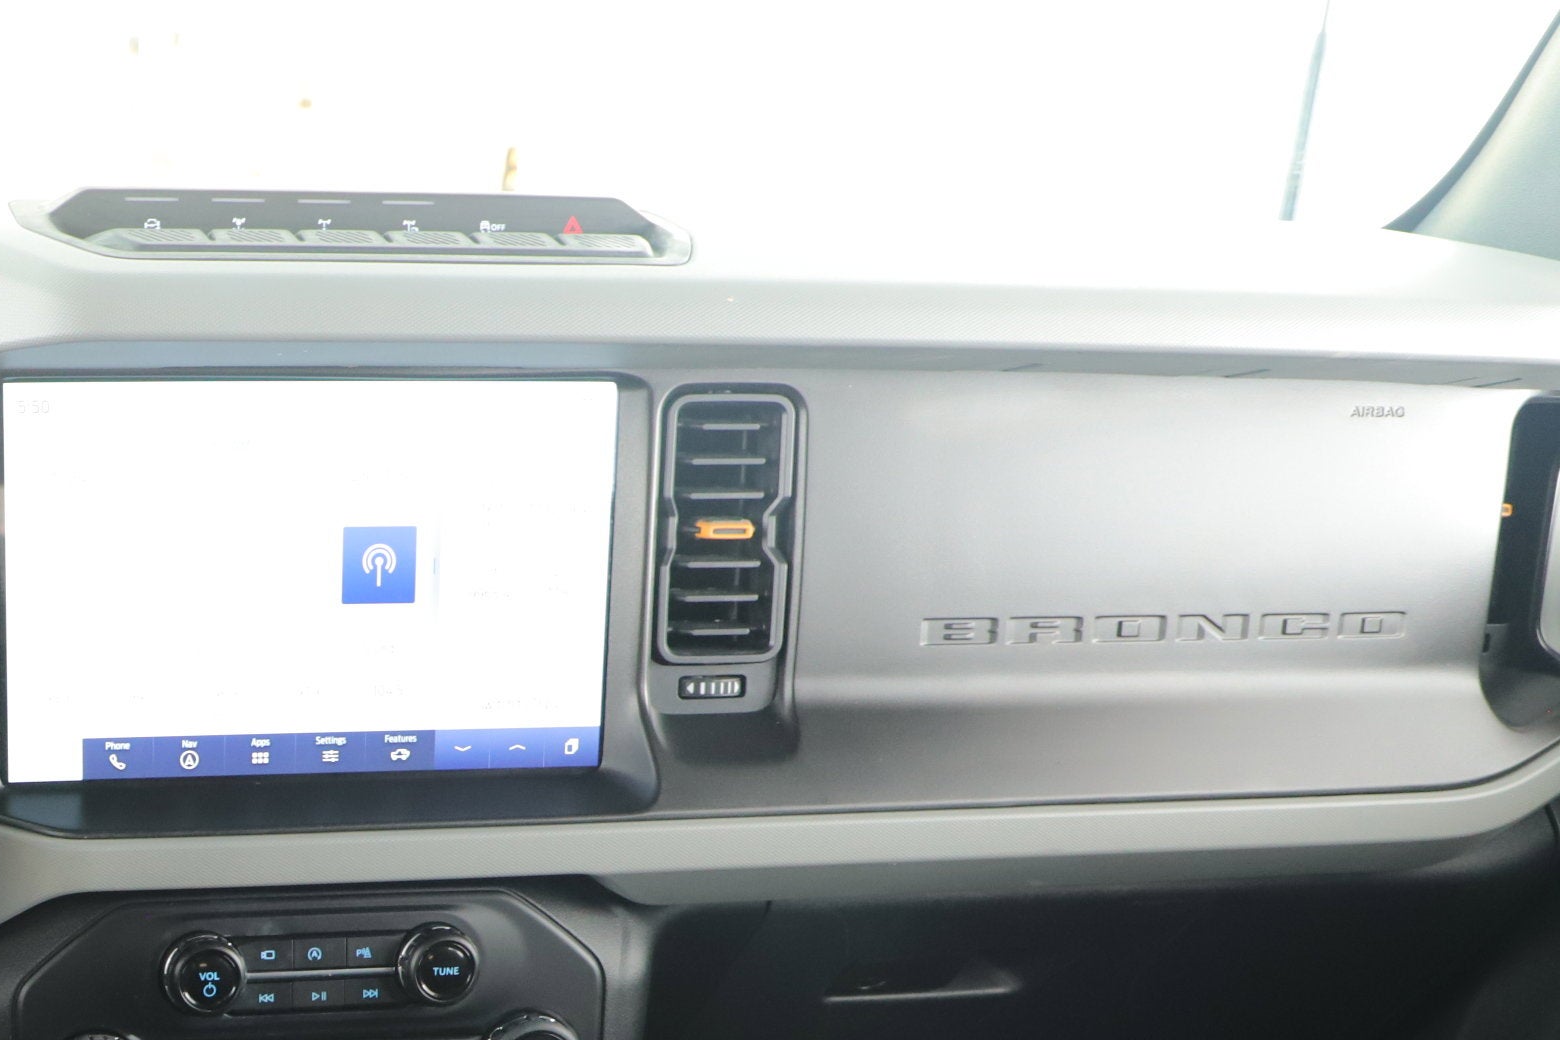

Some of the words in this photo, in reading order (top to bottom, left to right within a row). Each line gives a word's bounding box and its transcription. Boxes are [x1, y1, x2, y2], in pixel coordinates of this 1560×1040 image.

[490, 223, 506, 232] OFF
[1350, 404, 1405, 418] AIRBAG
[920, 610, 1408, 646] BRONCO
[251, 737, 271, 748] Apps
[315, 735, 347, 746] Settings
[384, 734, 418, 743] Features
[105, 741, 131, 750] Phone
[181, 739, 198, 749] Nav
[432, 966, 460, 976] TUNE
[199, 971, 220, 982] VOL
